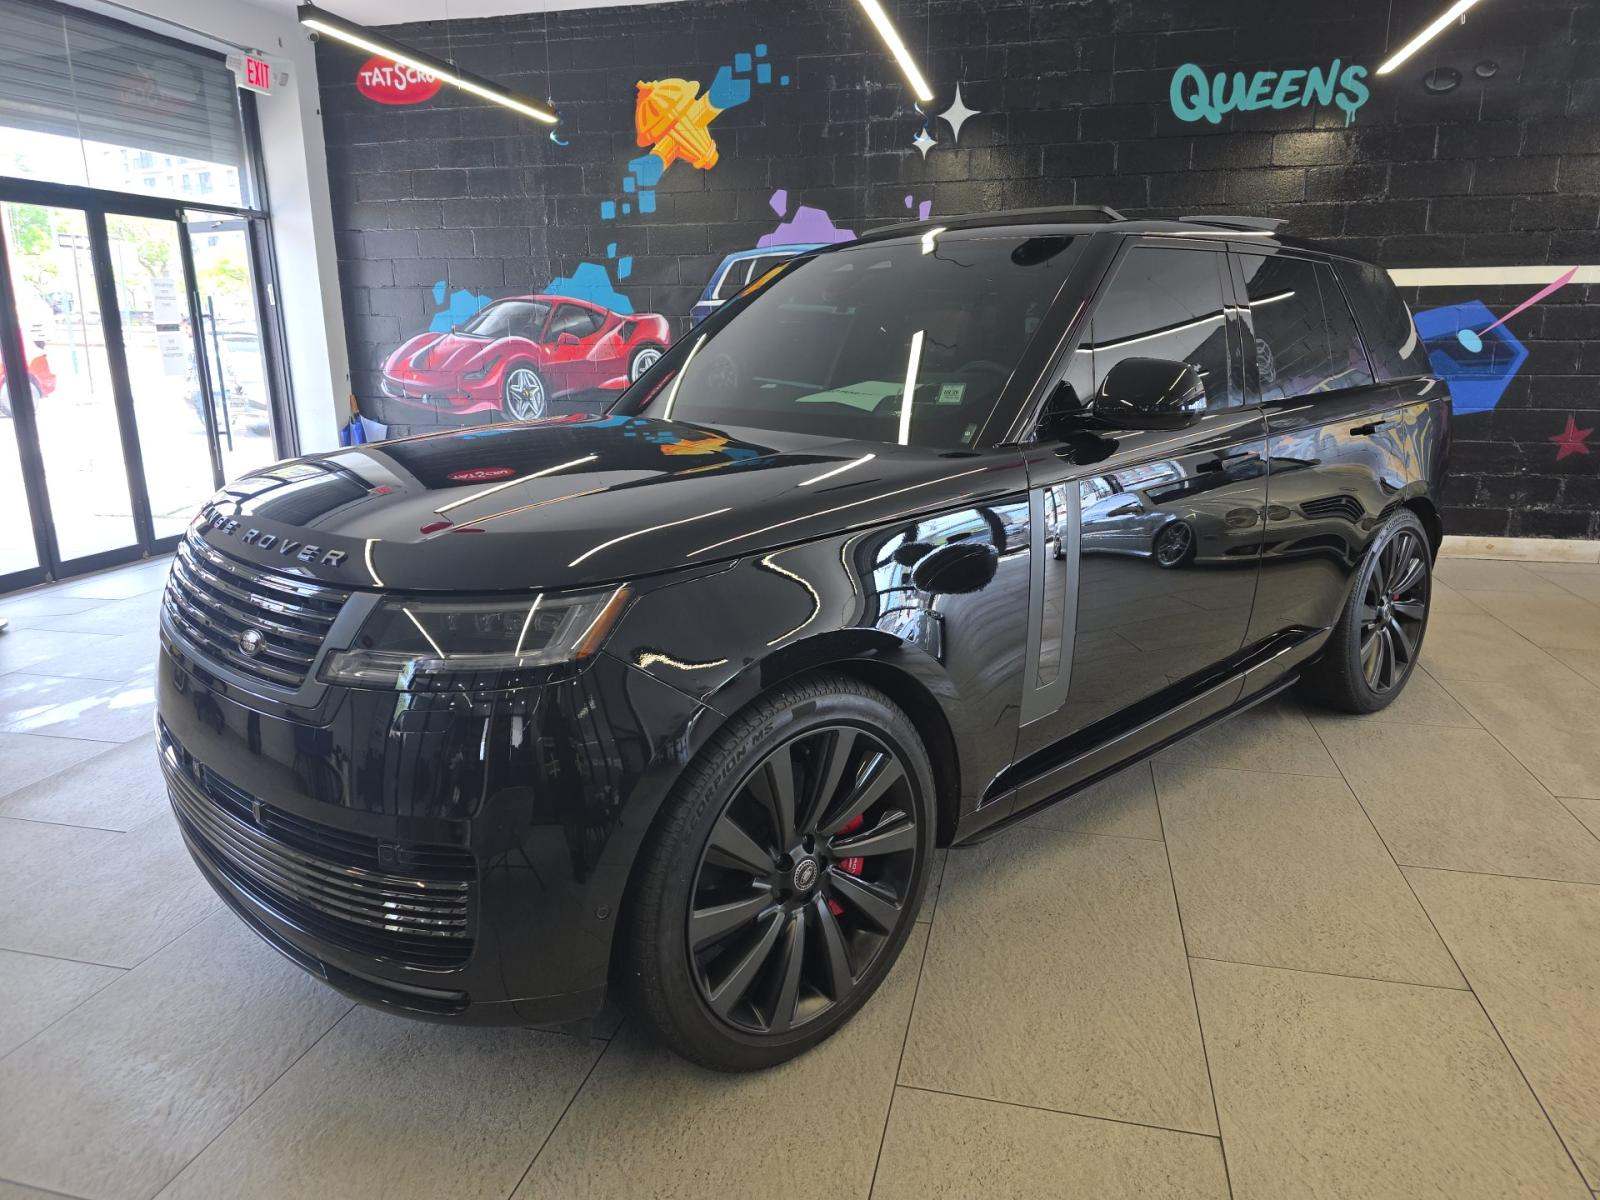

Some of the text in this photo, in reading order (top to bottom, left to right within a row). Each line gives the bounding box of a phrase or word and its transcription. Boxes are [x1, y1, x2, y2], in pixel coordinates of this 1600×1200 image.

[247, 58, 269, 89] EXIT
[1169, 59, 1370, 128] QUEENS
[242, 528, 349, 567] ROVER
